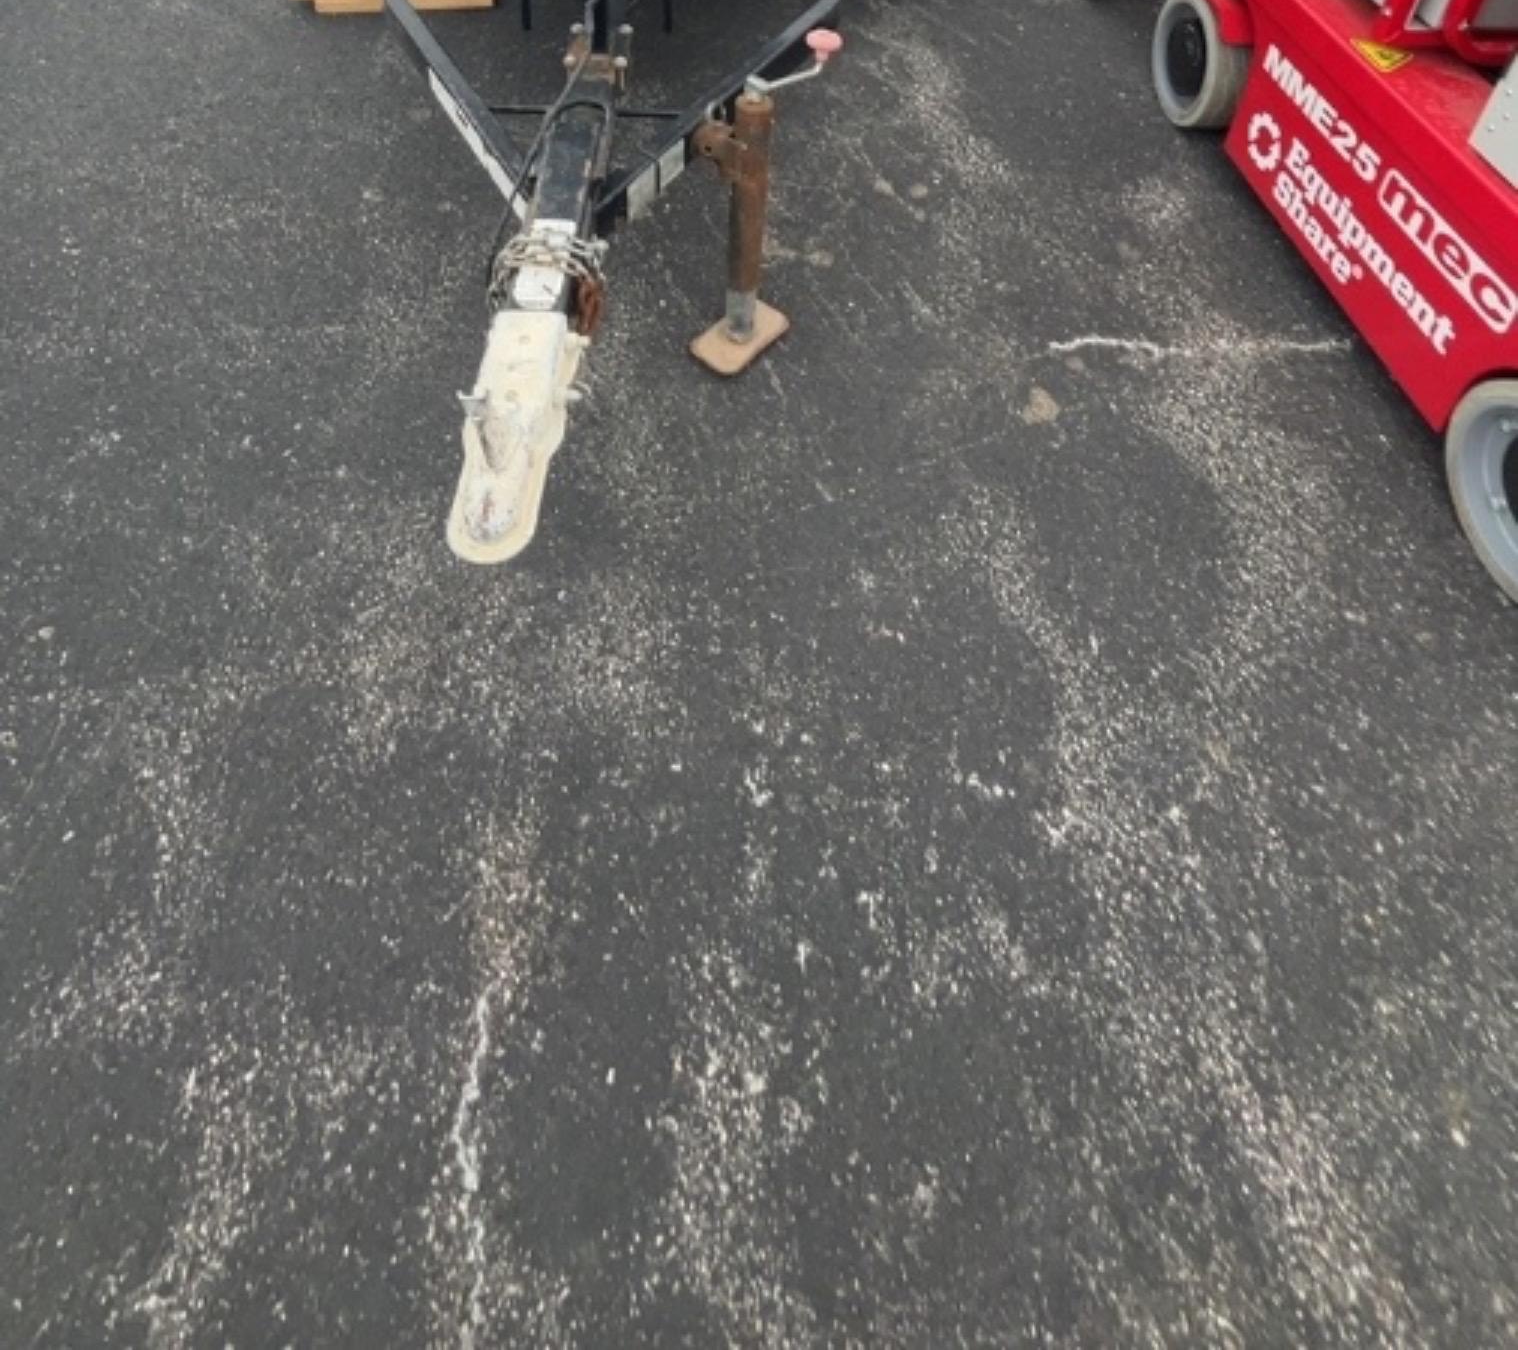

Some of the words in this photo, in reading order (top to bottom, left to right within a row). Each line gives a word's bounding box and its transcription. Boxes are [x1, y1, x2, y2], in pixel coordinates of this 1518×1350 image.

[1262, 44, 1382, 182] MME25
[1378, 169, 1518, 332] mec
[1285, 137, 1456, 355] Equipment
